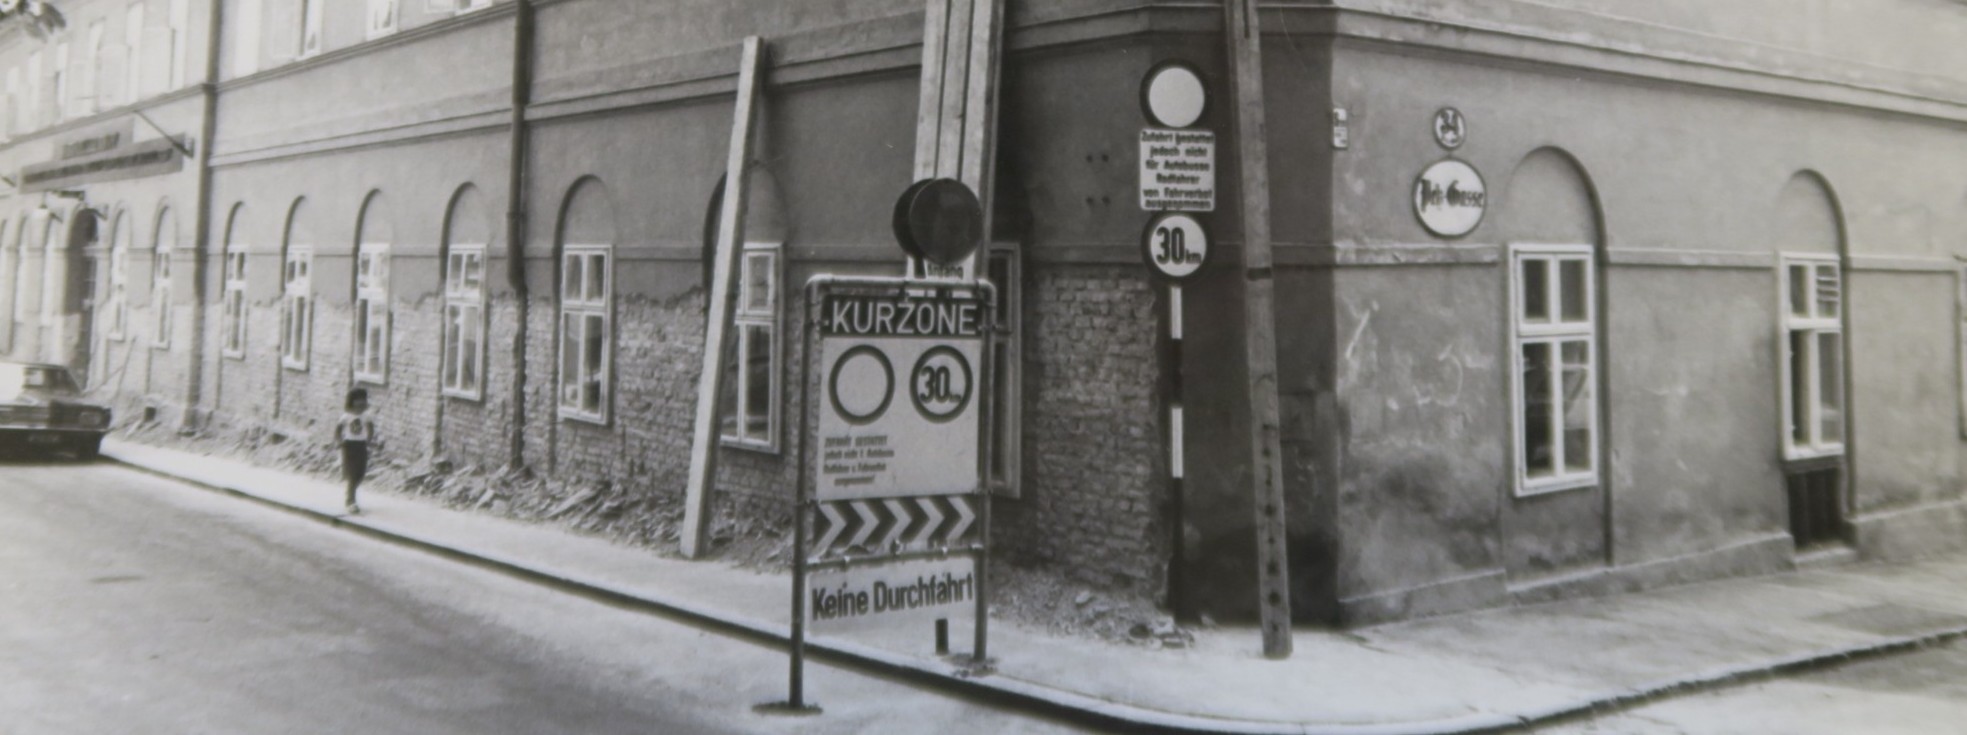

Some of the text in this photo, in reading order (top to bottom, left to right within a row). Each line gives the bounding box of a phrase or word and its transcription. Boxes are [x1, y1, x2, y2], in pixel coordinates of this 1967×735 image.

[1141, 131, 1173, 142] Zufahrt
[1149, 146, 1207, 158] jedoch nicht
[1163, 160, 1210, 172] Autobusse
[1156, 173, 1200, 185] Radfahrer
[1164, 187, 1213, 199] Fahrverbot
[1156, 226, 1185, 265] 30
[832, 301, 977, 335] KURZONE
[920, 365, 950, 403] 30
[812, 572, 973, 620] Keine Durchfahrt
